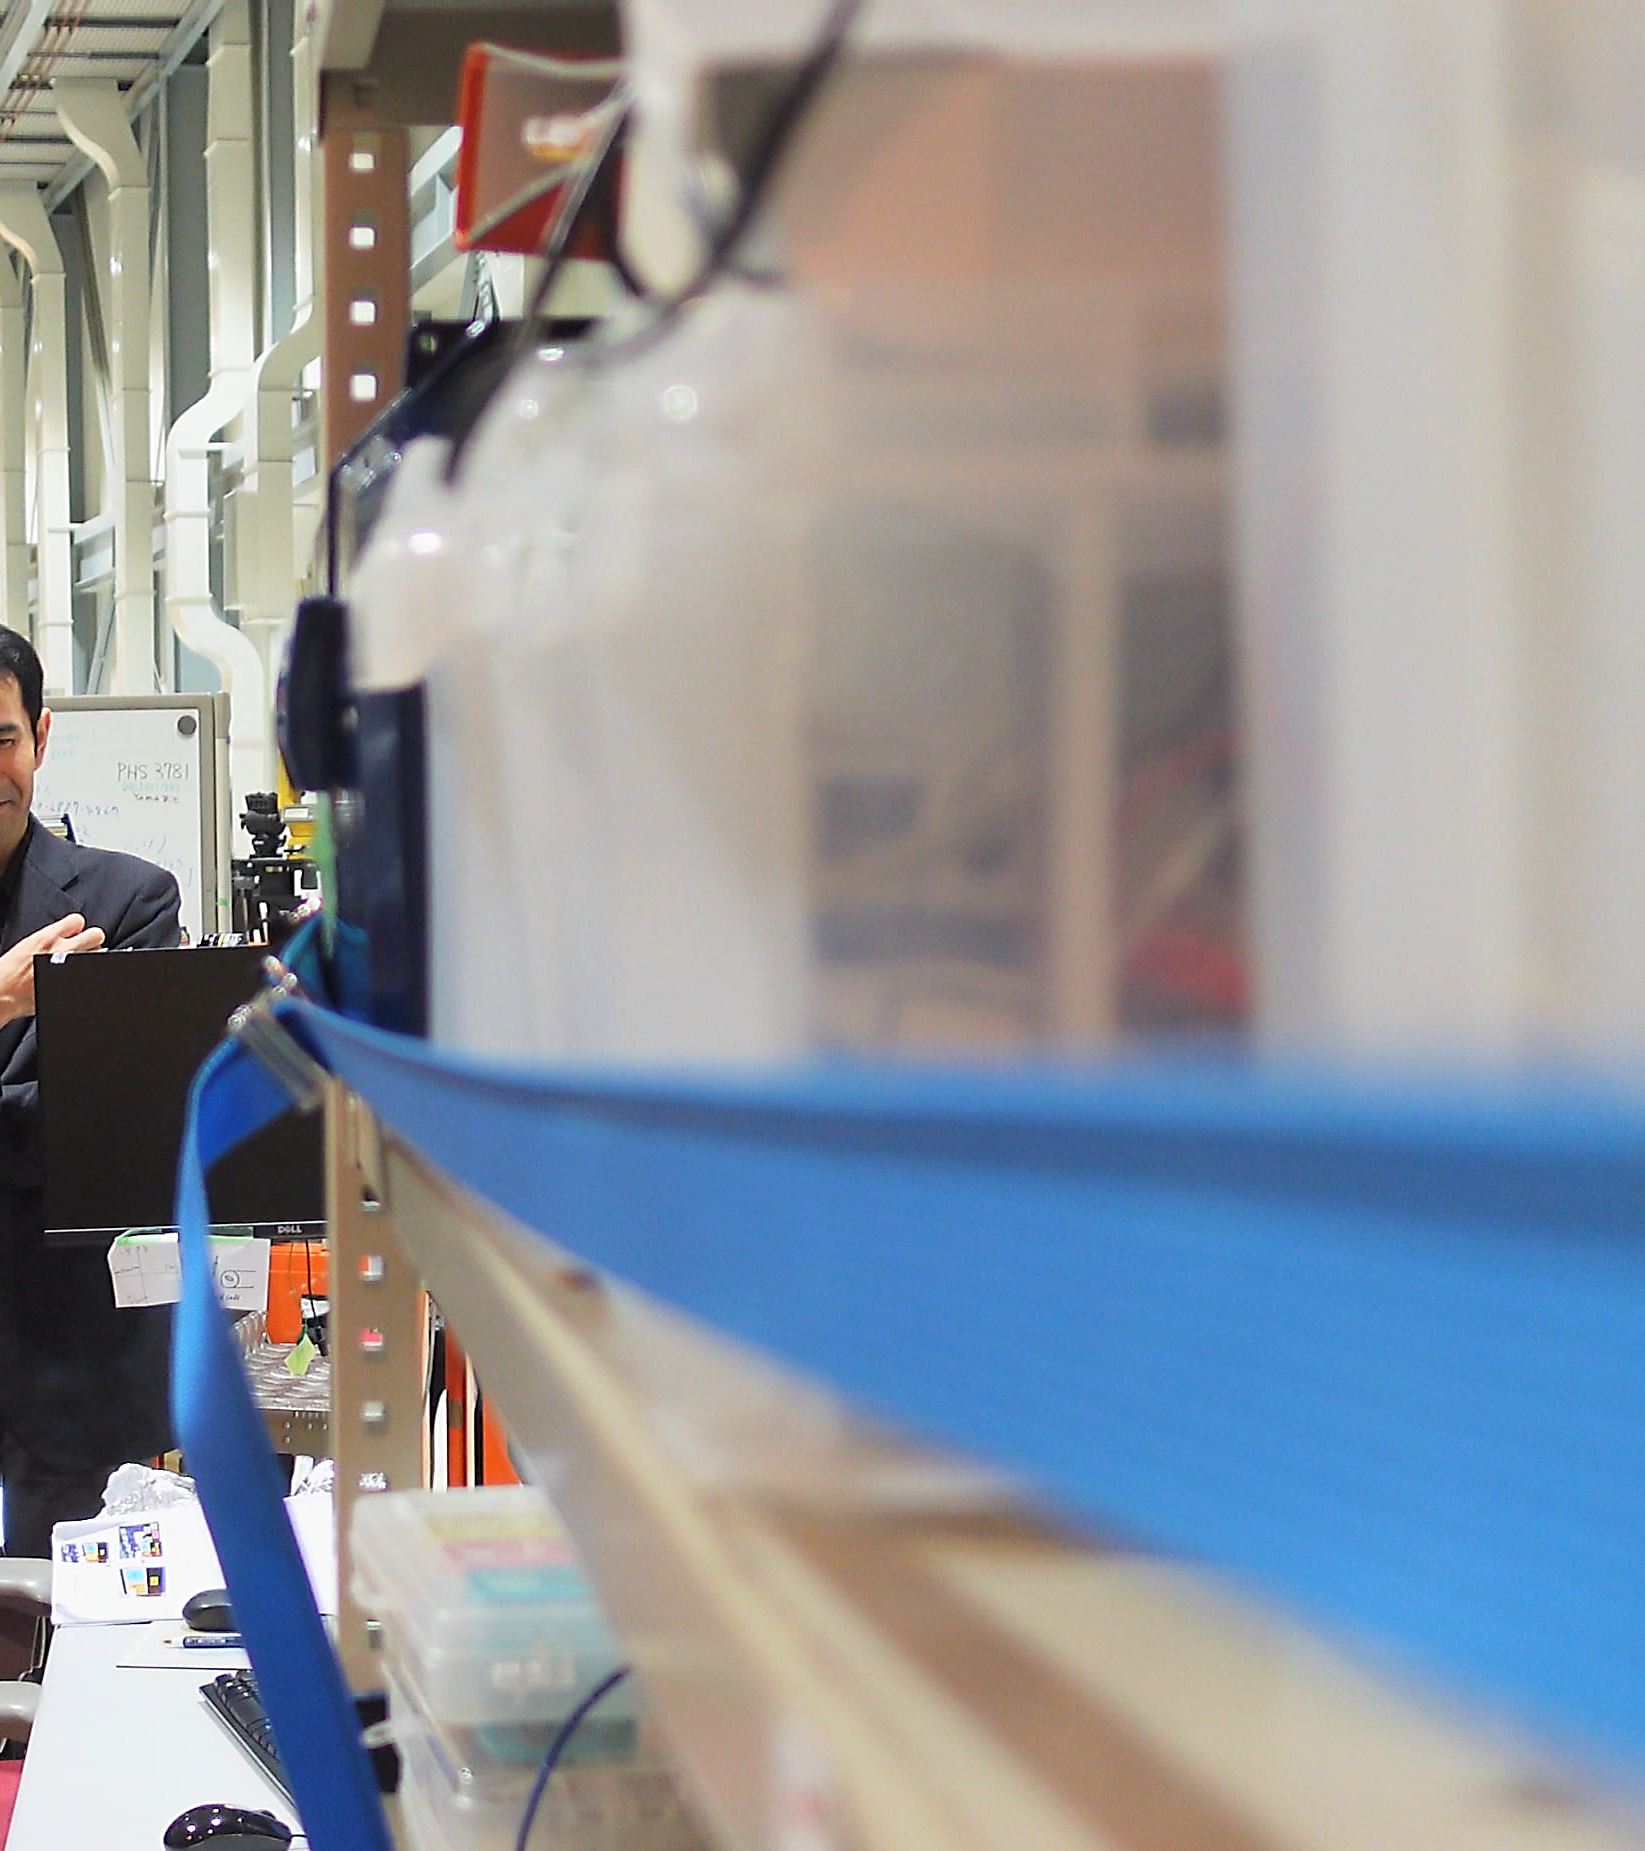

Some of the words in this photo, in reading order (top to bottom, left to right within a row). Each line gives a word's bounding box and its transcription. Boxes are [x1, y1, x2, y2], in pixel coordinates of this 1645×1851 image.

[117, 762, 148, 781] PHS
[154, 761, 189, 780] 3781
[277, 1225, 303, 1234] DELL
